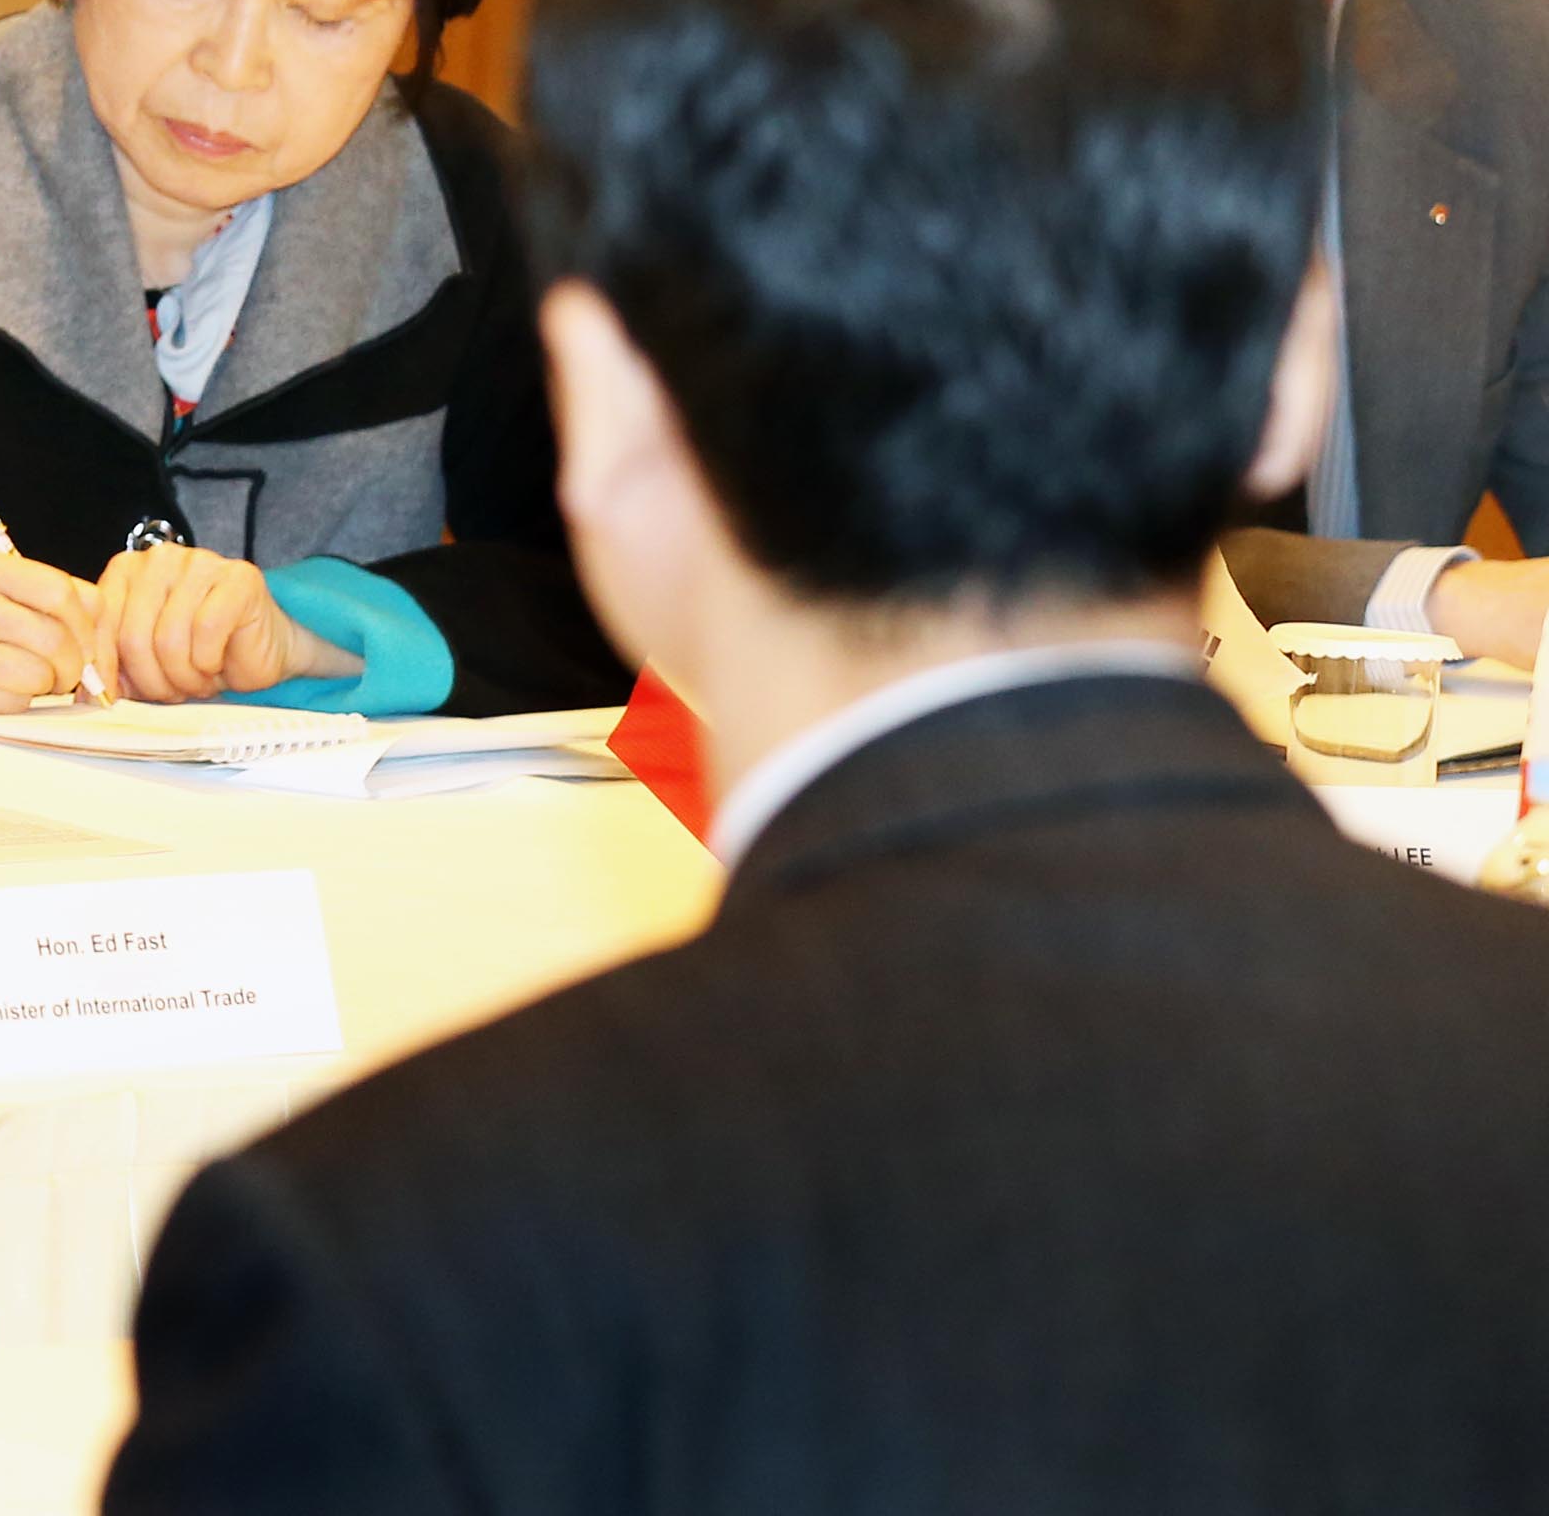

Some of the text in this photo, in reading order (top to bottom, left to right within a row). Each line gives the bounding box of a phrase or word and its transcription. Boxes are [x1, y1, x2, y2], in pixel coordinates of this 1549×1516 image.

[36, 931, 168, 957] Hon. Ed Fast
[52, 998, 71, 1018] of
[75, 990, 196, 1016] International
[200, 987, 257, 1010] Trade
